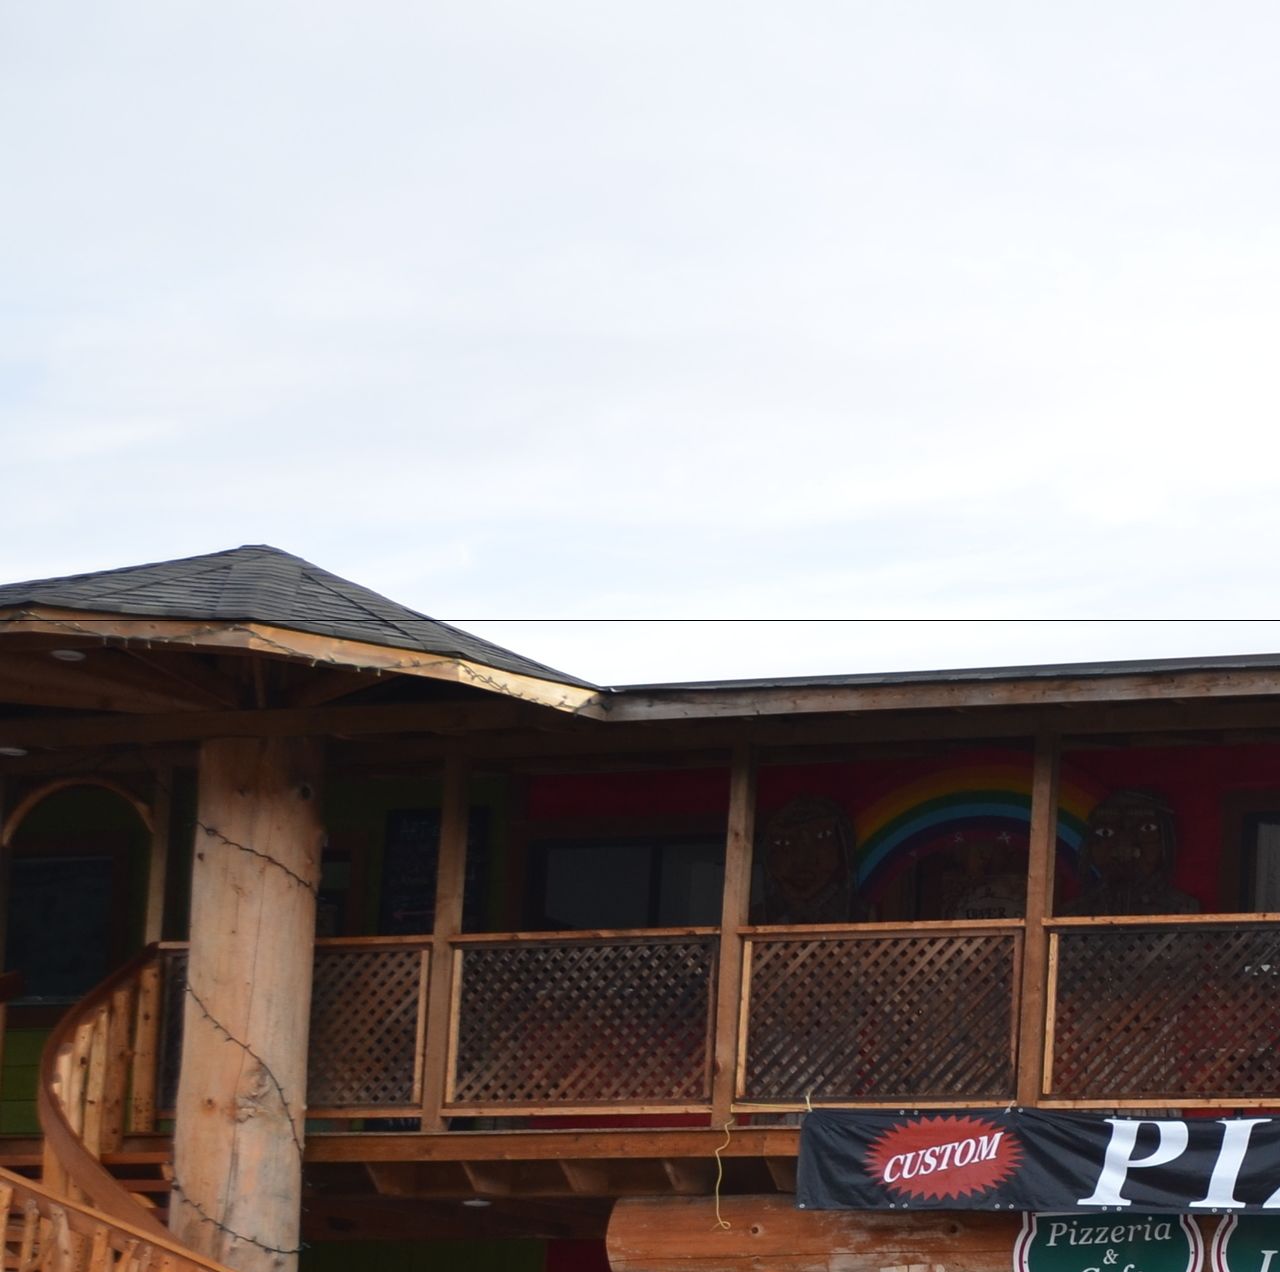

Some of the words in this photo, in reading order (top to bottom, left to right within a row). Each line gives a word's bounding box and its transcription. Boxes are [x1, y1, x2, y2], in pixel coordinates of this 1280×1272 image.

[883, 1131, 1004, 1183] CUSTOM
[1045, 1215, 1172, 1247] Pizzeria
[1102, 1248, 1119, 1264] &
